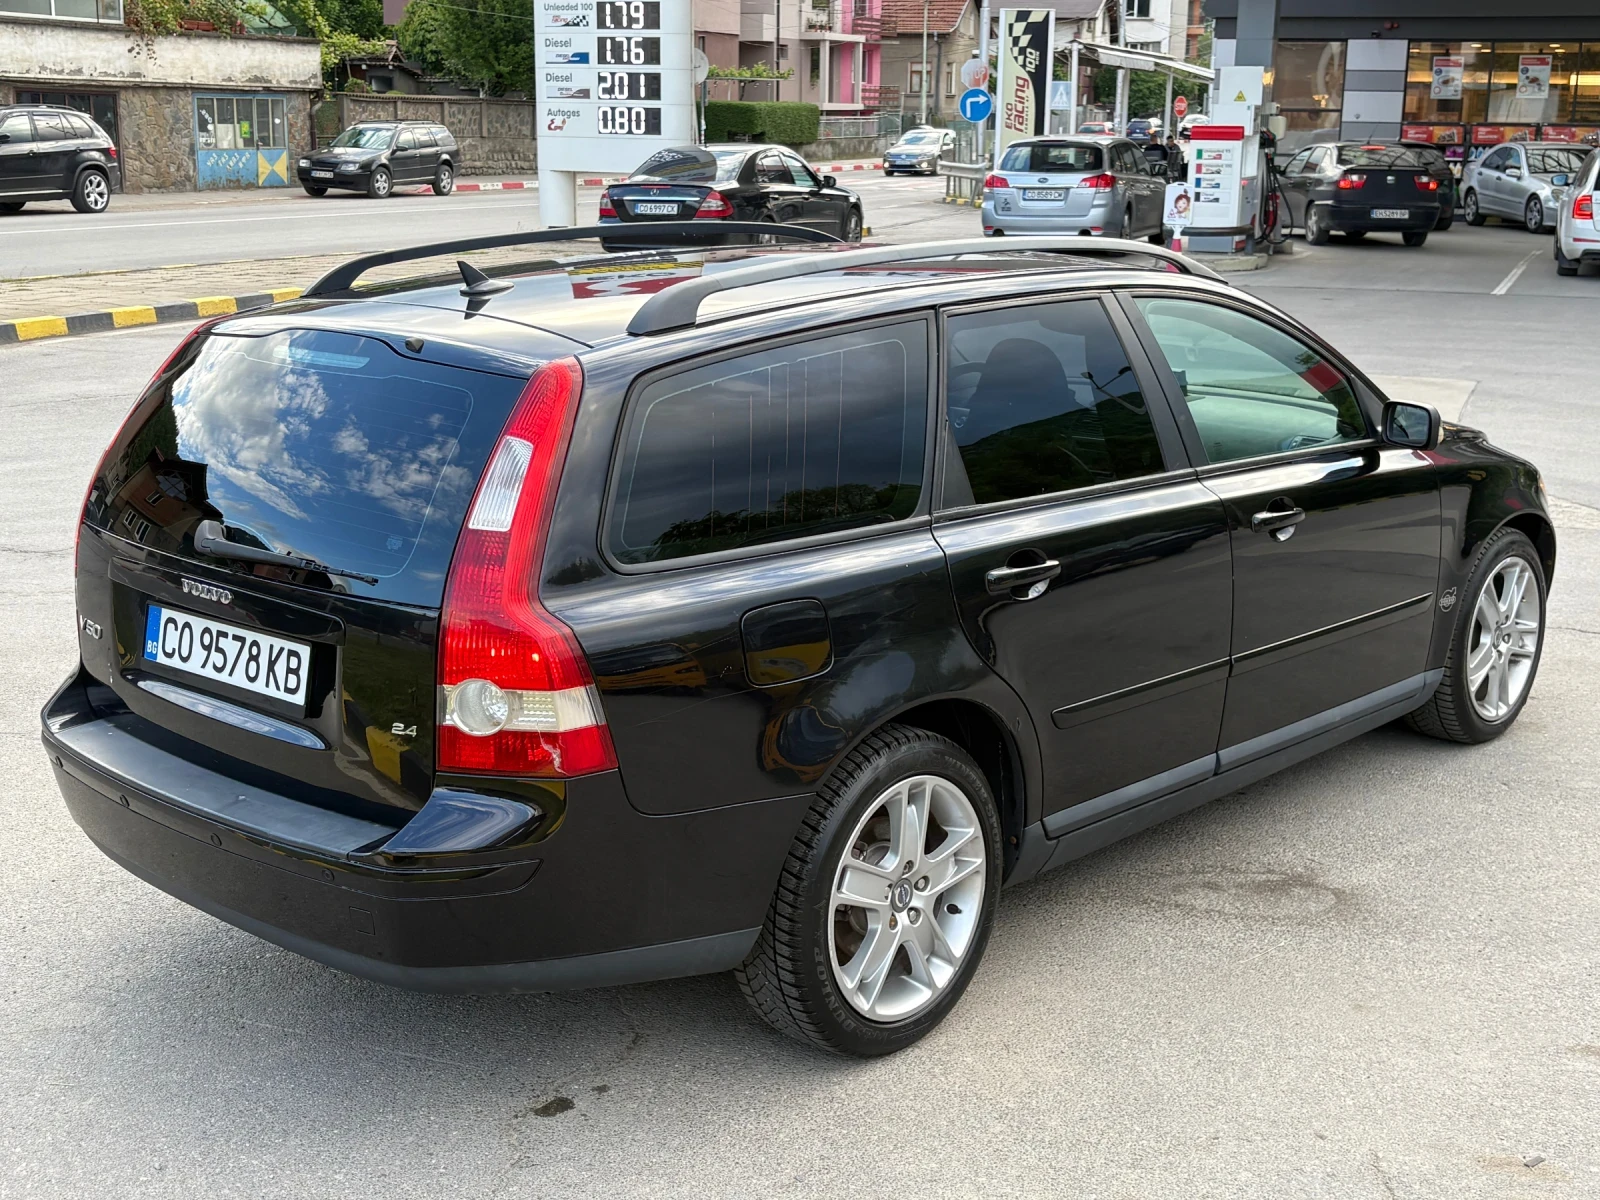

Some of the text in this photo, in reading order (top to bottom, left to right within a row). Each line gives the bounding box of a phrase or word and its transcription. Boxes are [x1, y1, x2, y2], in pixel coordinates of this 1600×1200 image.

[544, 2, 594, 11] Unleaded 100
[605, 1, 645, 29] 1.79
[544, 38, 572, 48] Diesel
[606, 37, 645, 65] 1.76
[1025, 47, 1036, 73] 100
[545, 73, 573, 83] Diesel
[598, 72, 646, 99] 2.01
[547, 108, 581, 119] Autogas
[1004, 102, 1014, 130] EKO
[1013, 75, 1030, 134] racing
[598, 106, 646, 134] 0.80
[639, 204, 649, 213] CO
[649, 204, 666, 213] 6997
[180, 578, 233, 605] VOLVO
[79, 614, 103, 640] V50
[145, 639, 158, 655] BG
[161, 616, 302, 696] CO 9578 KB
[813, 946, 858, 1033] DUNLOP
